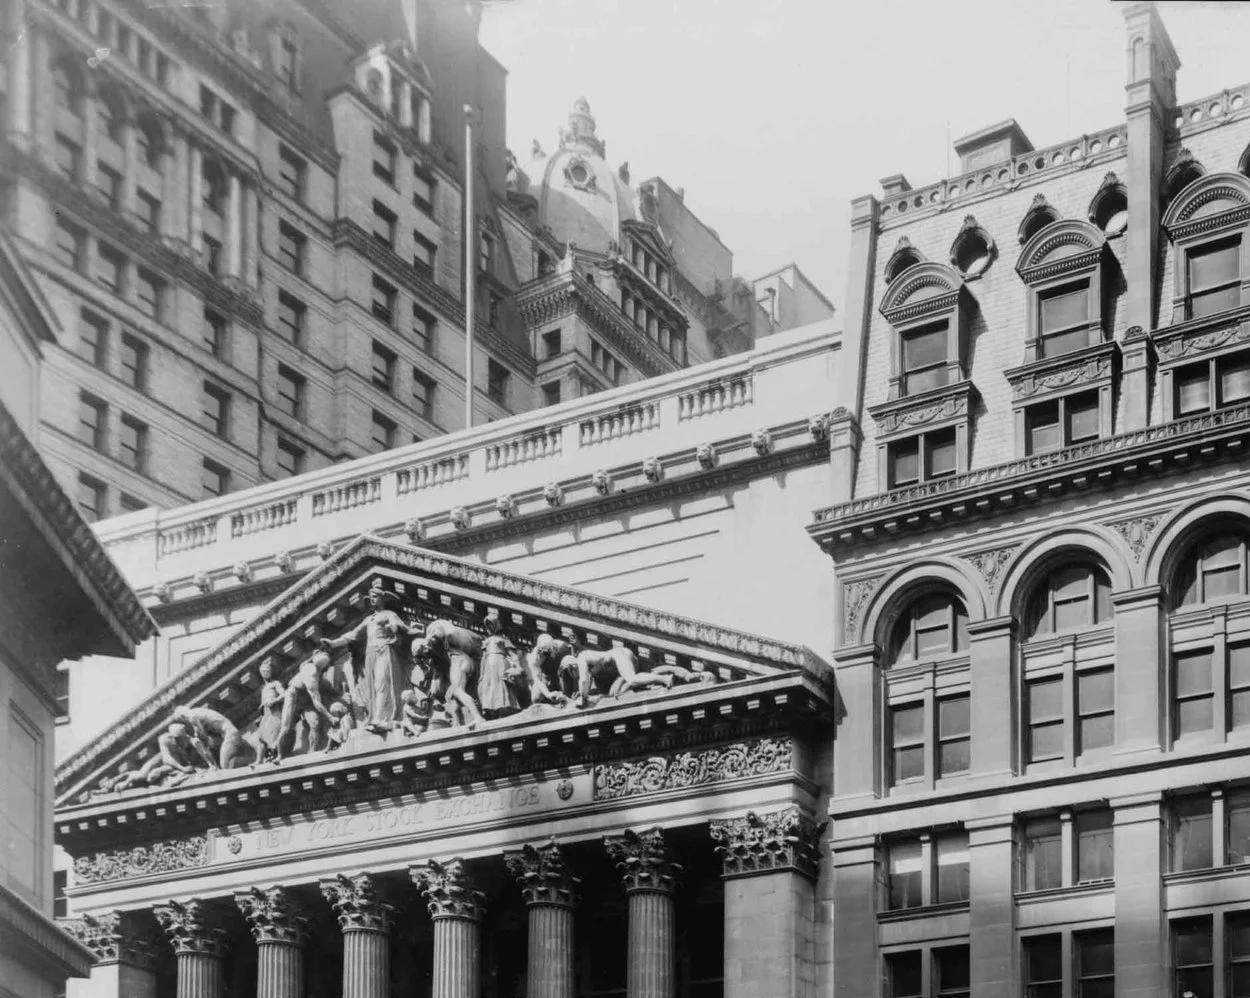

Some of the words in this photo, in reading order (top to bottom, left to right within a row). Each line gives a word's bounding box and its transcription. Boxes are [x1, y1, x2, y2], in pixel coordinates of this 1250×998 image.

[256, 825, 296, 851] NEW
[306, 817, 355, 842] YORK
[366, 804, 424, 832] STOCK
[436, 786, 540, 820] EXCHANGE
